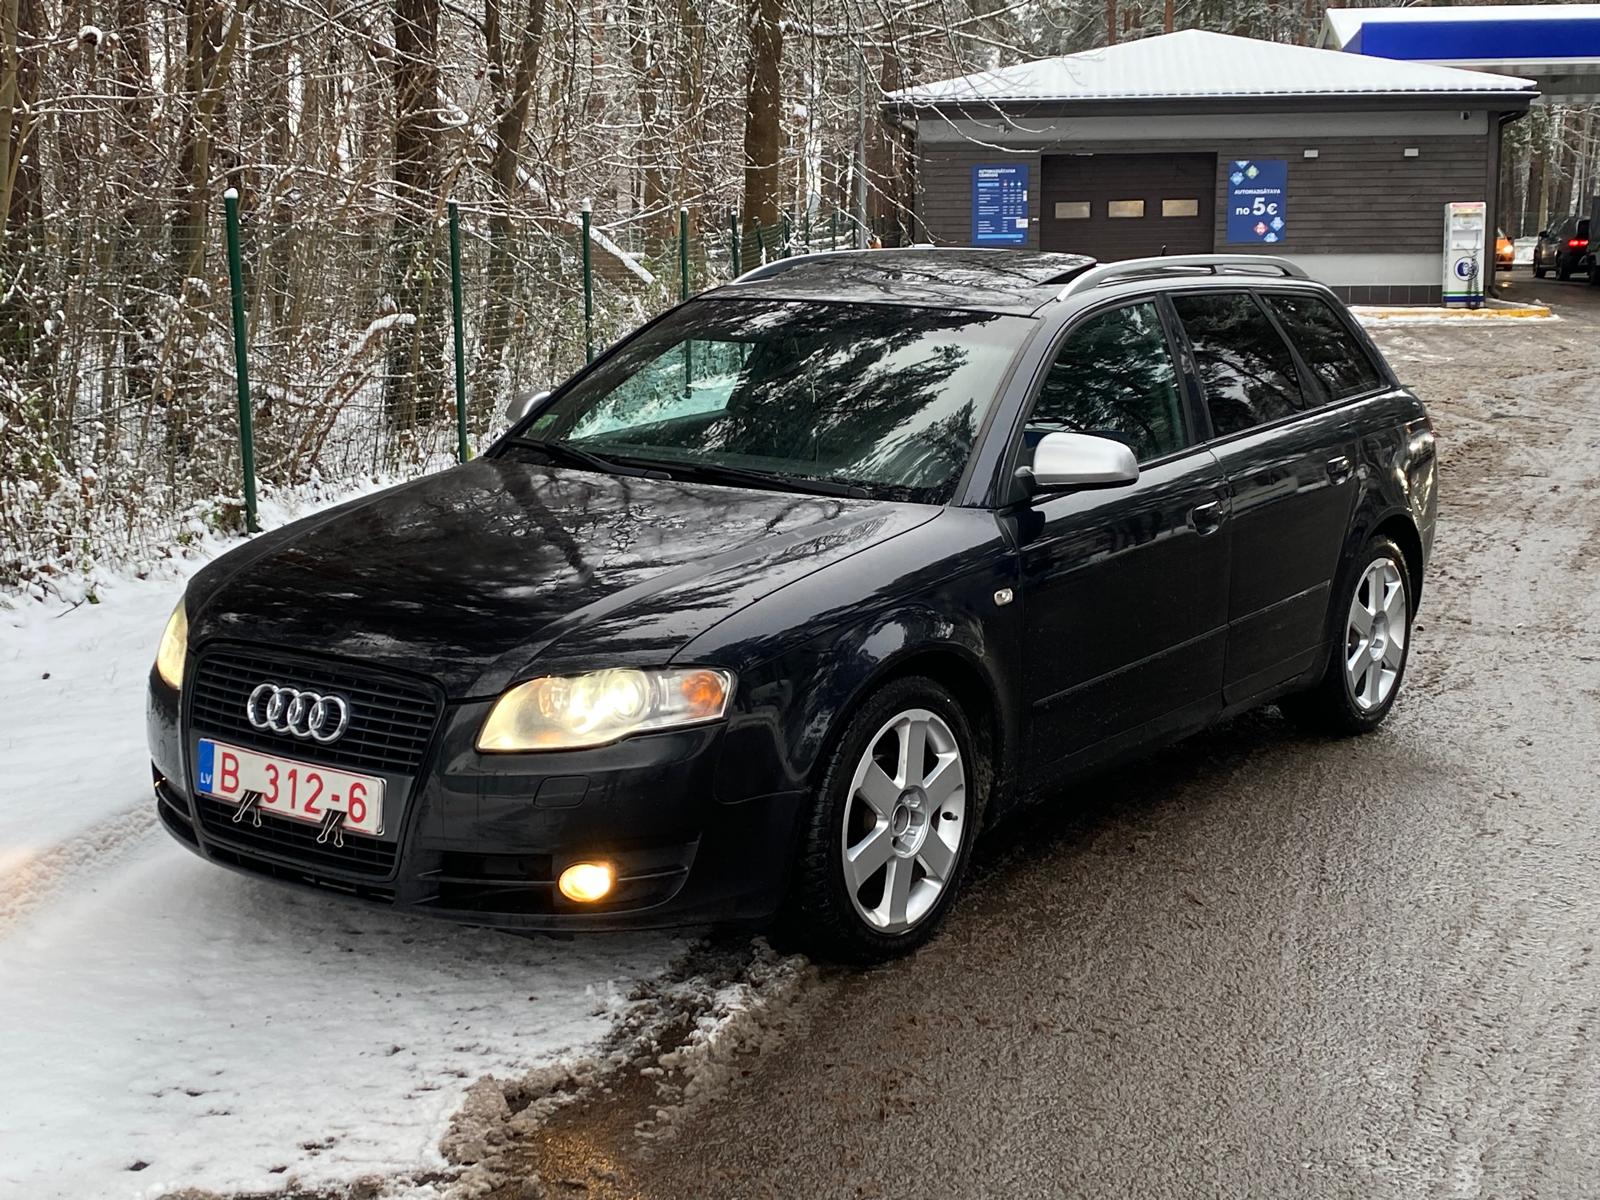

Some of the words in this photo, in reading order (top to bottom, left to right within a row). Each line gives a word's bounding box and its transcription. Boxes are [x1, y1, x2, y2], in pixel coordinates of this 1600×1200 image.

[200, 772, 212, 784] LV
[220, 751, 239, 793] B
[263, 763, 367, 823] 312-6
